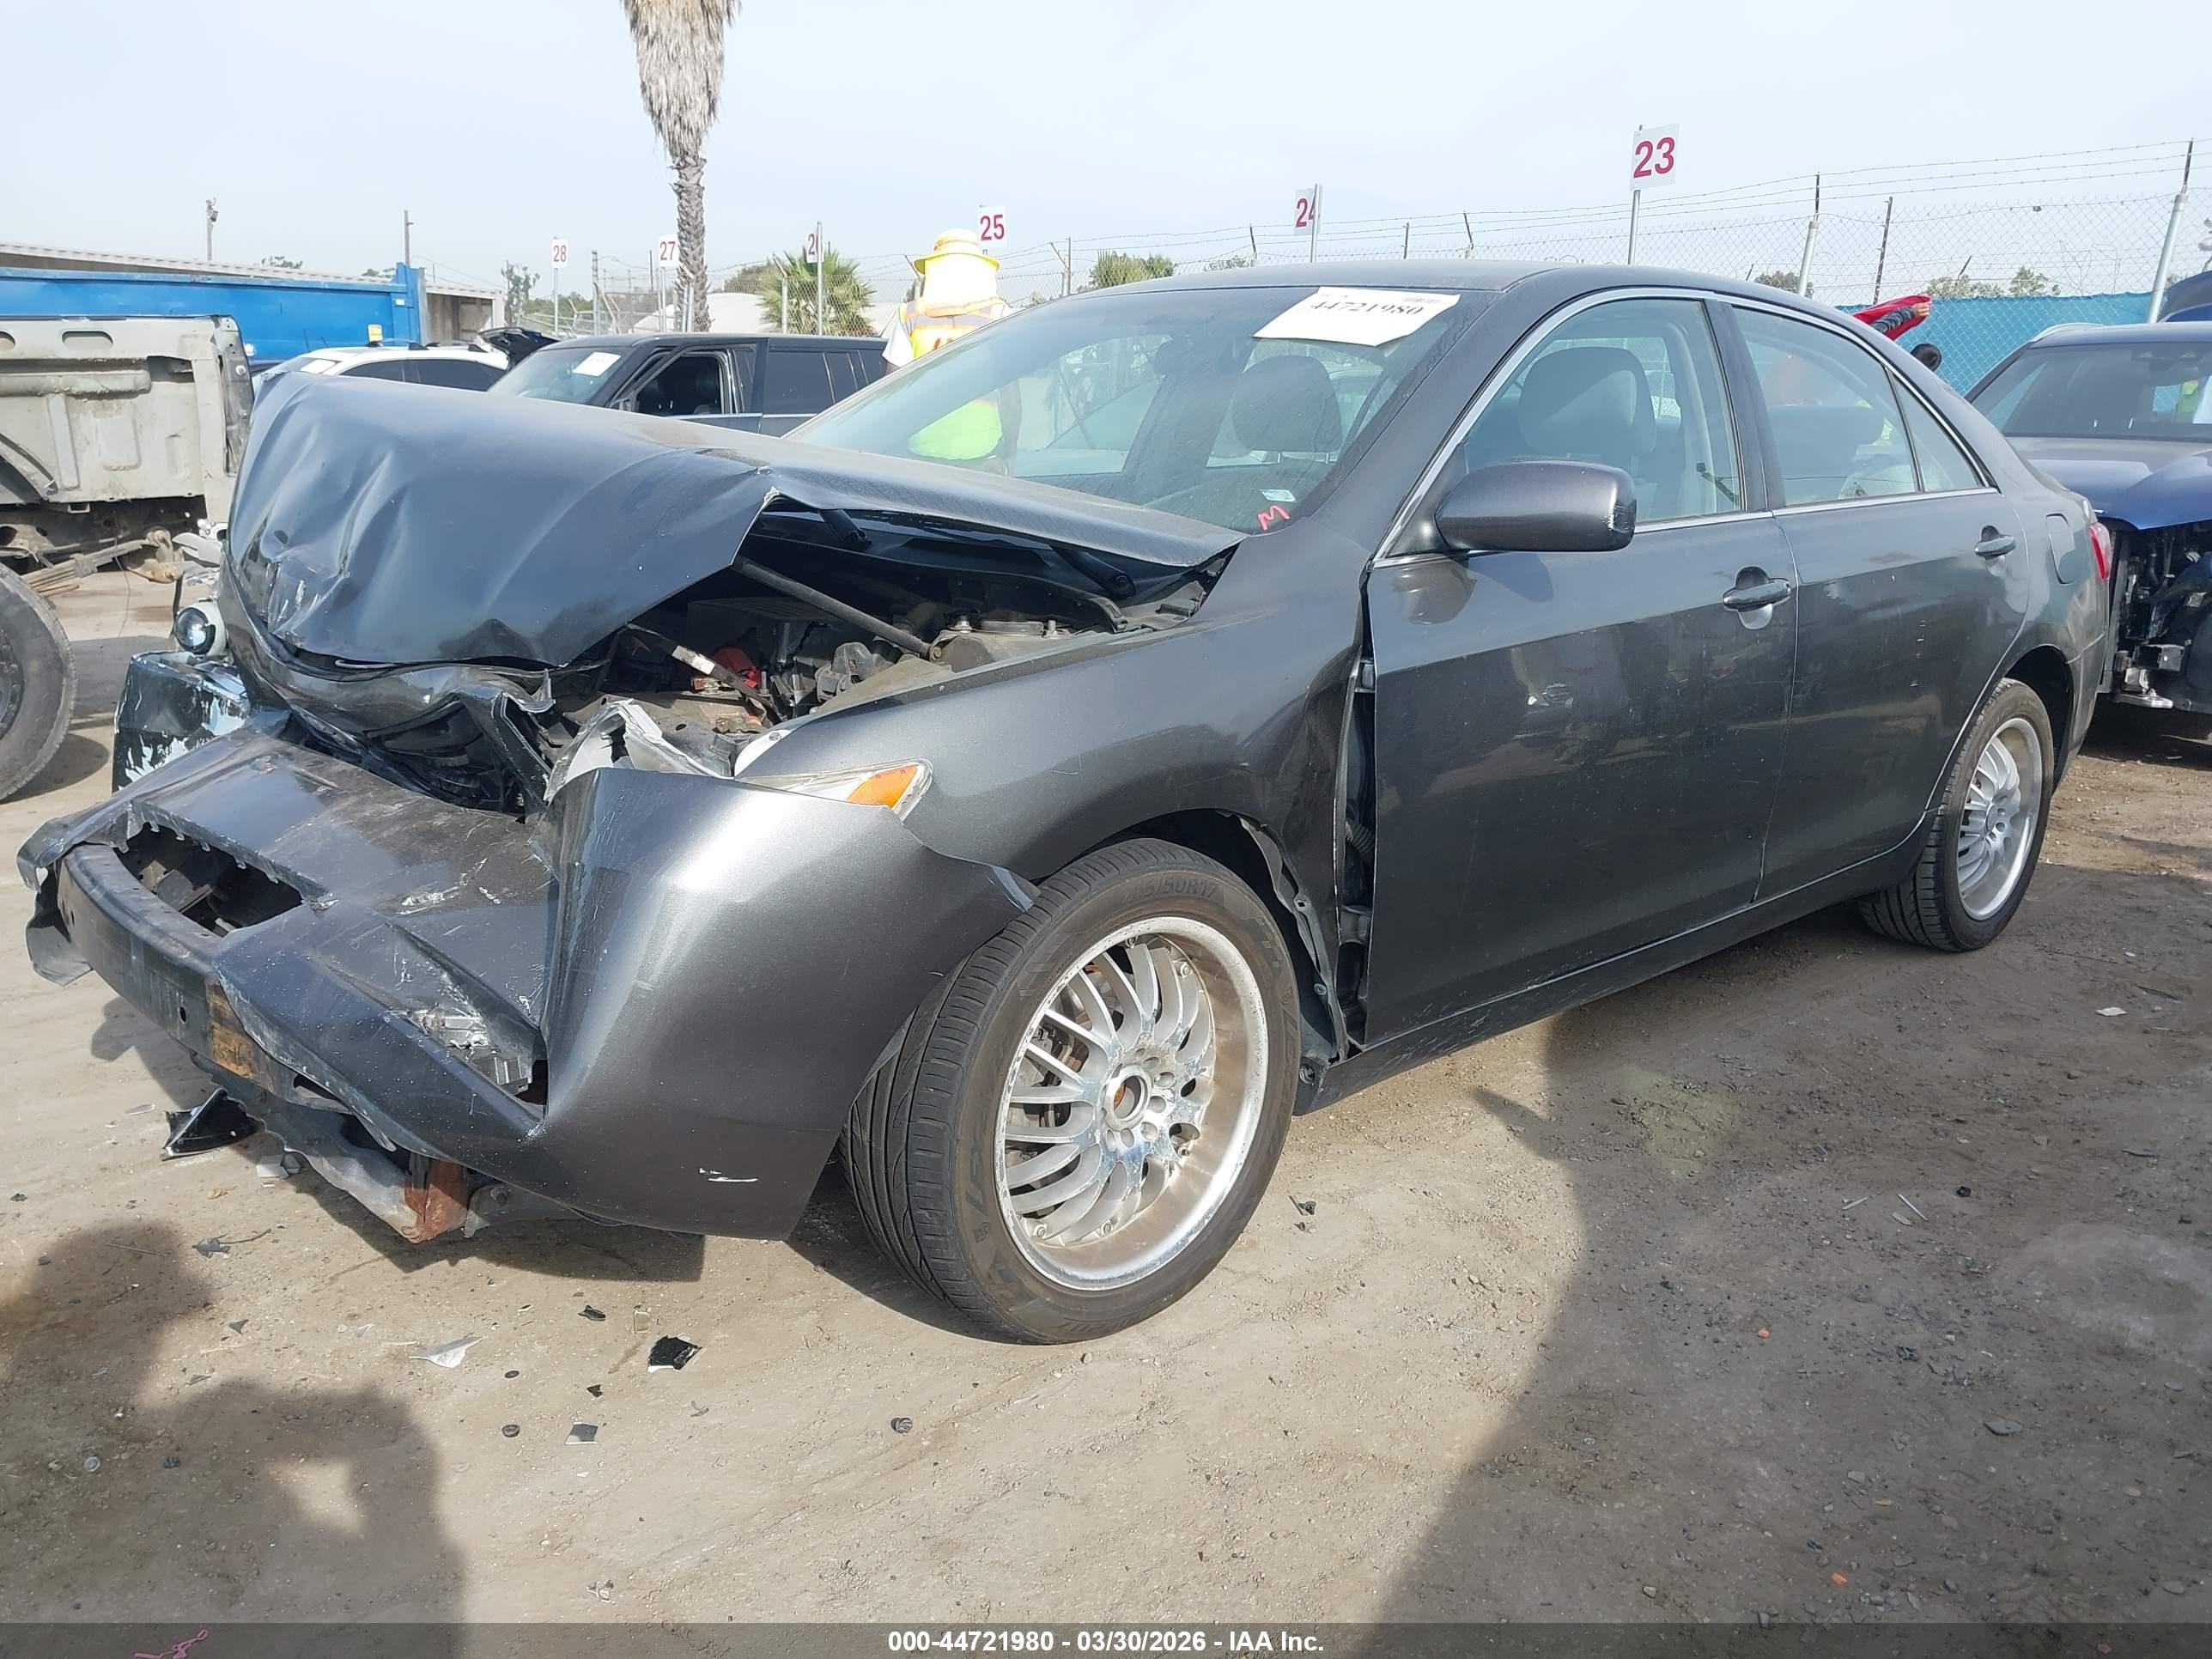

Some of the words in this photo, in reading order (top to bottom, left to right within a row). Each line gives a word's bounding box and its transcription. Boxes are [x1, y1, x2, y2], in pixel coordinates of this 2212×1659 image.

[1633, 137, 1675, 179] 23
[980, 214, 1005, 241] 25
[553, 244, 567, 262] 28
[659, 241, 676, 261] 27
[807, 233, 818, 255] 2
[1310, 301, 1425, 315] 44721980
